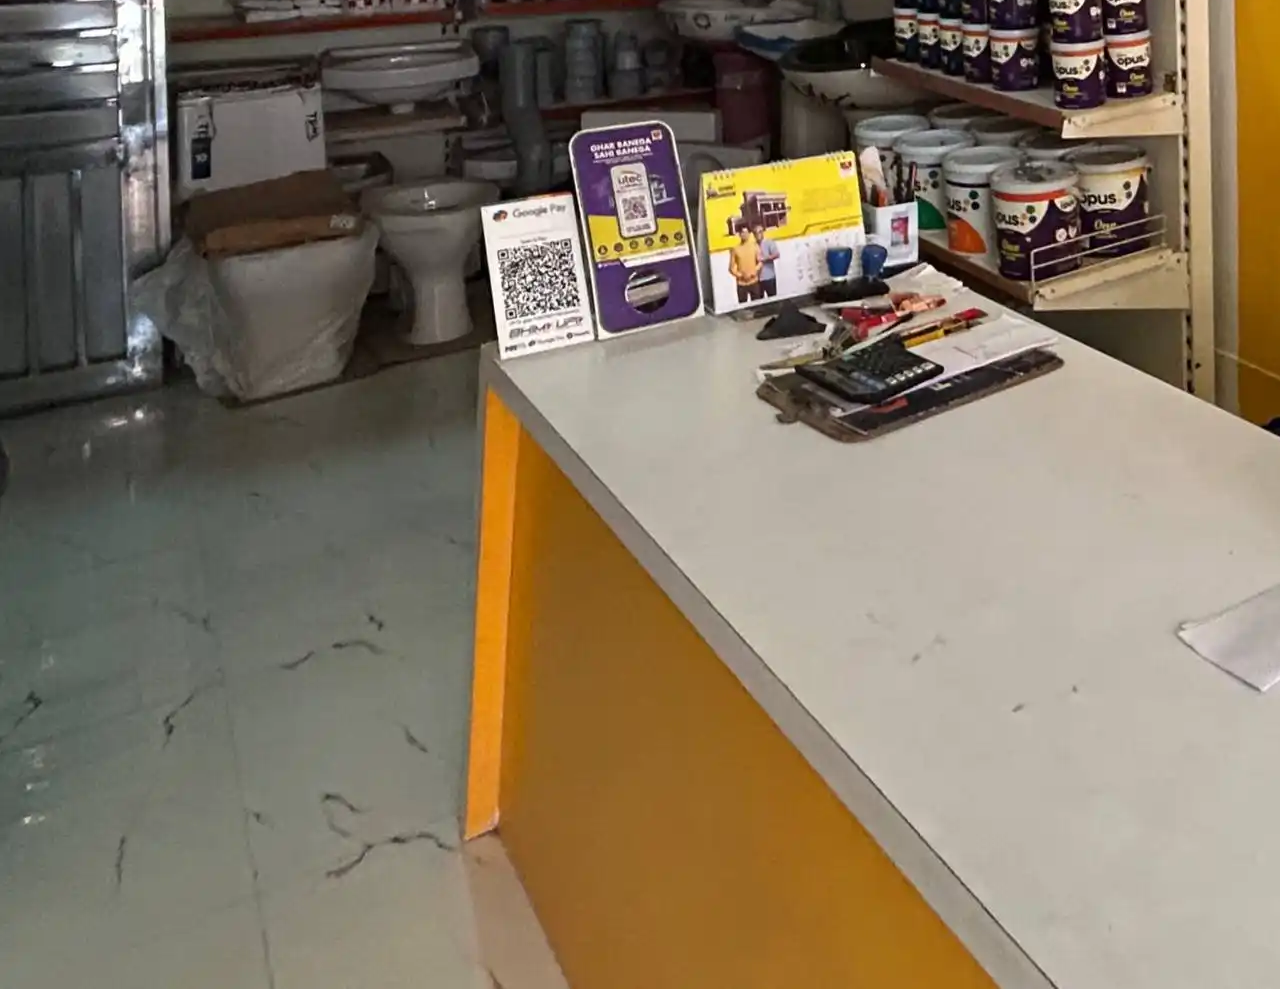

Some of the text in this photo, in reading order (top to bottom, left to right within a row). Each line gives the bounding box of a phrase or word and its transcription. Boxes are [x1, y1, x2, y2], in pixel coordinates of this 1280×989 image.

[1117, 55, 1144, 65] opus
[512, 203, 567, 219] Google Pay
